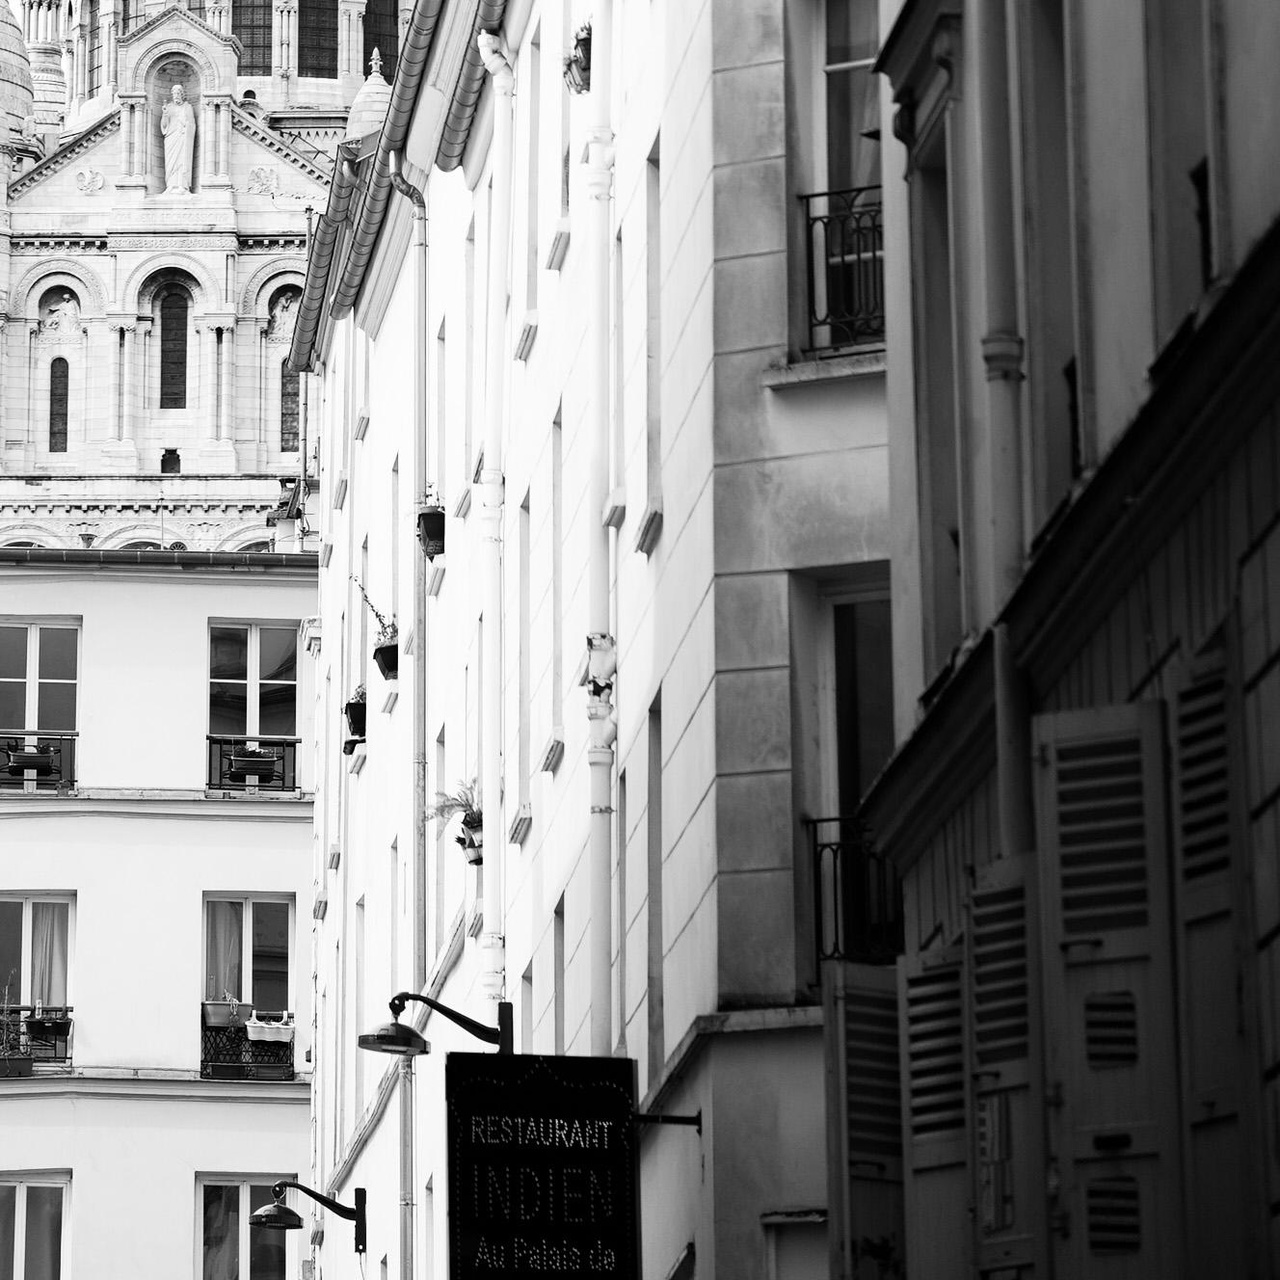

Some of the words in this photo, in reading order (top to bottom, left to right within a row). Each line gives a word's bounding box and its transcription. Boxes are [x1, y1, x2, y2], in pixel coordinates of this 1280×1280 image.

[470, 1115, 614, 1149] RESTAURANT
[473, 1163, 614, 1223] INDIEN
[474, 1235, 506, 1269] Au
[513, 1236, 581, 1271] Palais
